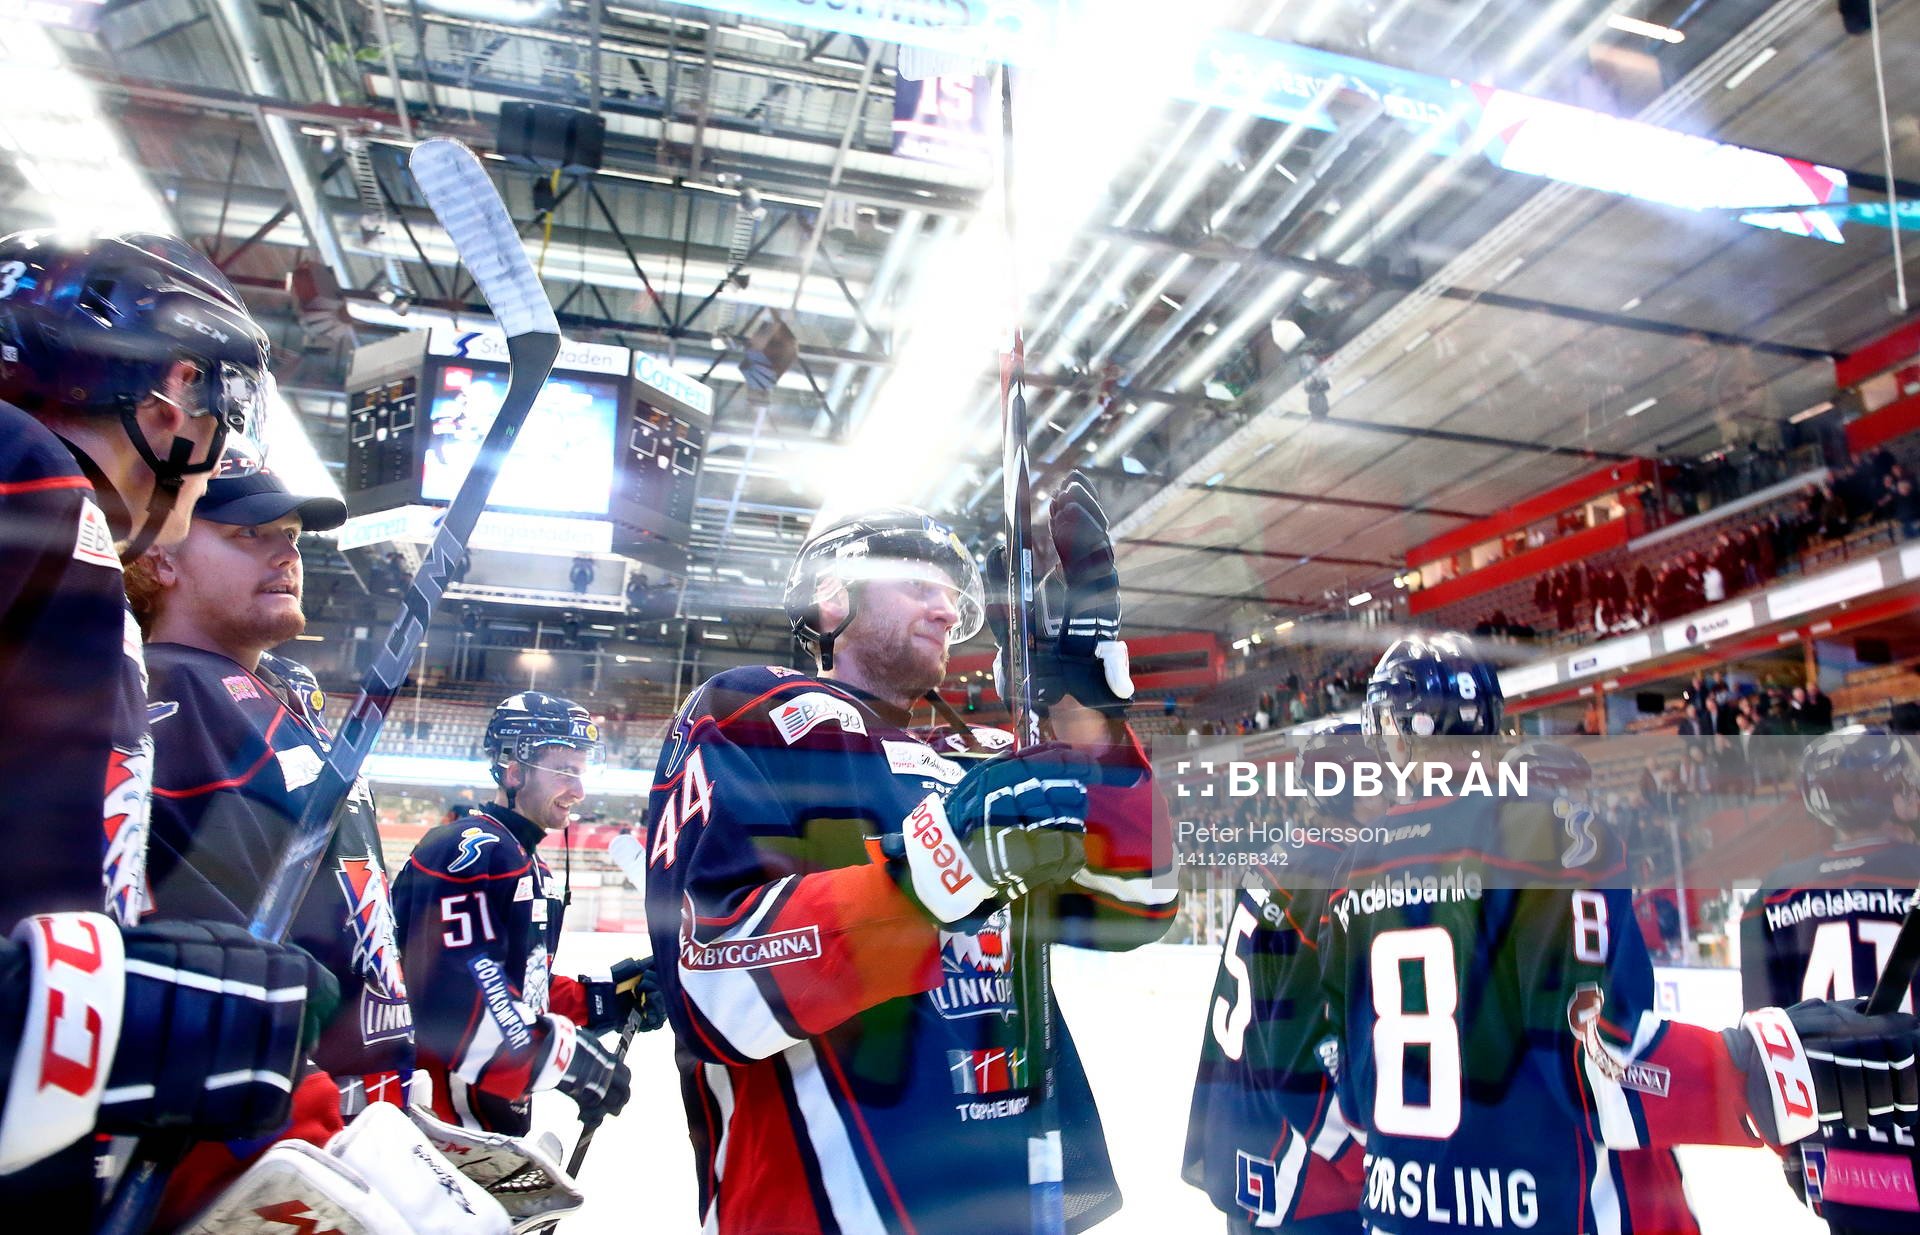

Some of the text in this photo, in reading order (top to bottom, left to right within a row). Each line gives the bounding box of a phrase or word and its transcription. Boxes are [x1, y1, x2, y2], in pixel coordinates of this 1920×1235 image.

[651, 746, 715, 869] 44
[911, 803, 974, 896] Reebo
[441, 891, 496, 948] 51
[1571, 889, 1609, 965] 8
[1370, 926, 1462, 1139] 8
[1749, 1010, 1814, 1121] CC
[1363, 1153, 1539, 1230] FORSLING
